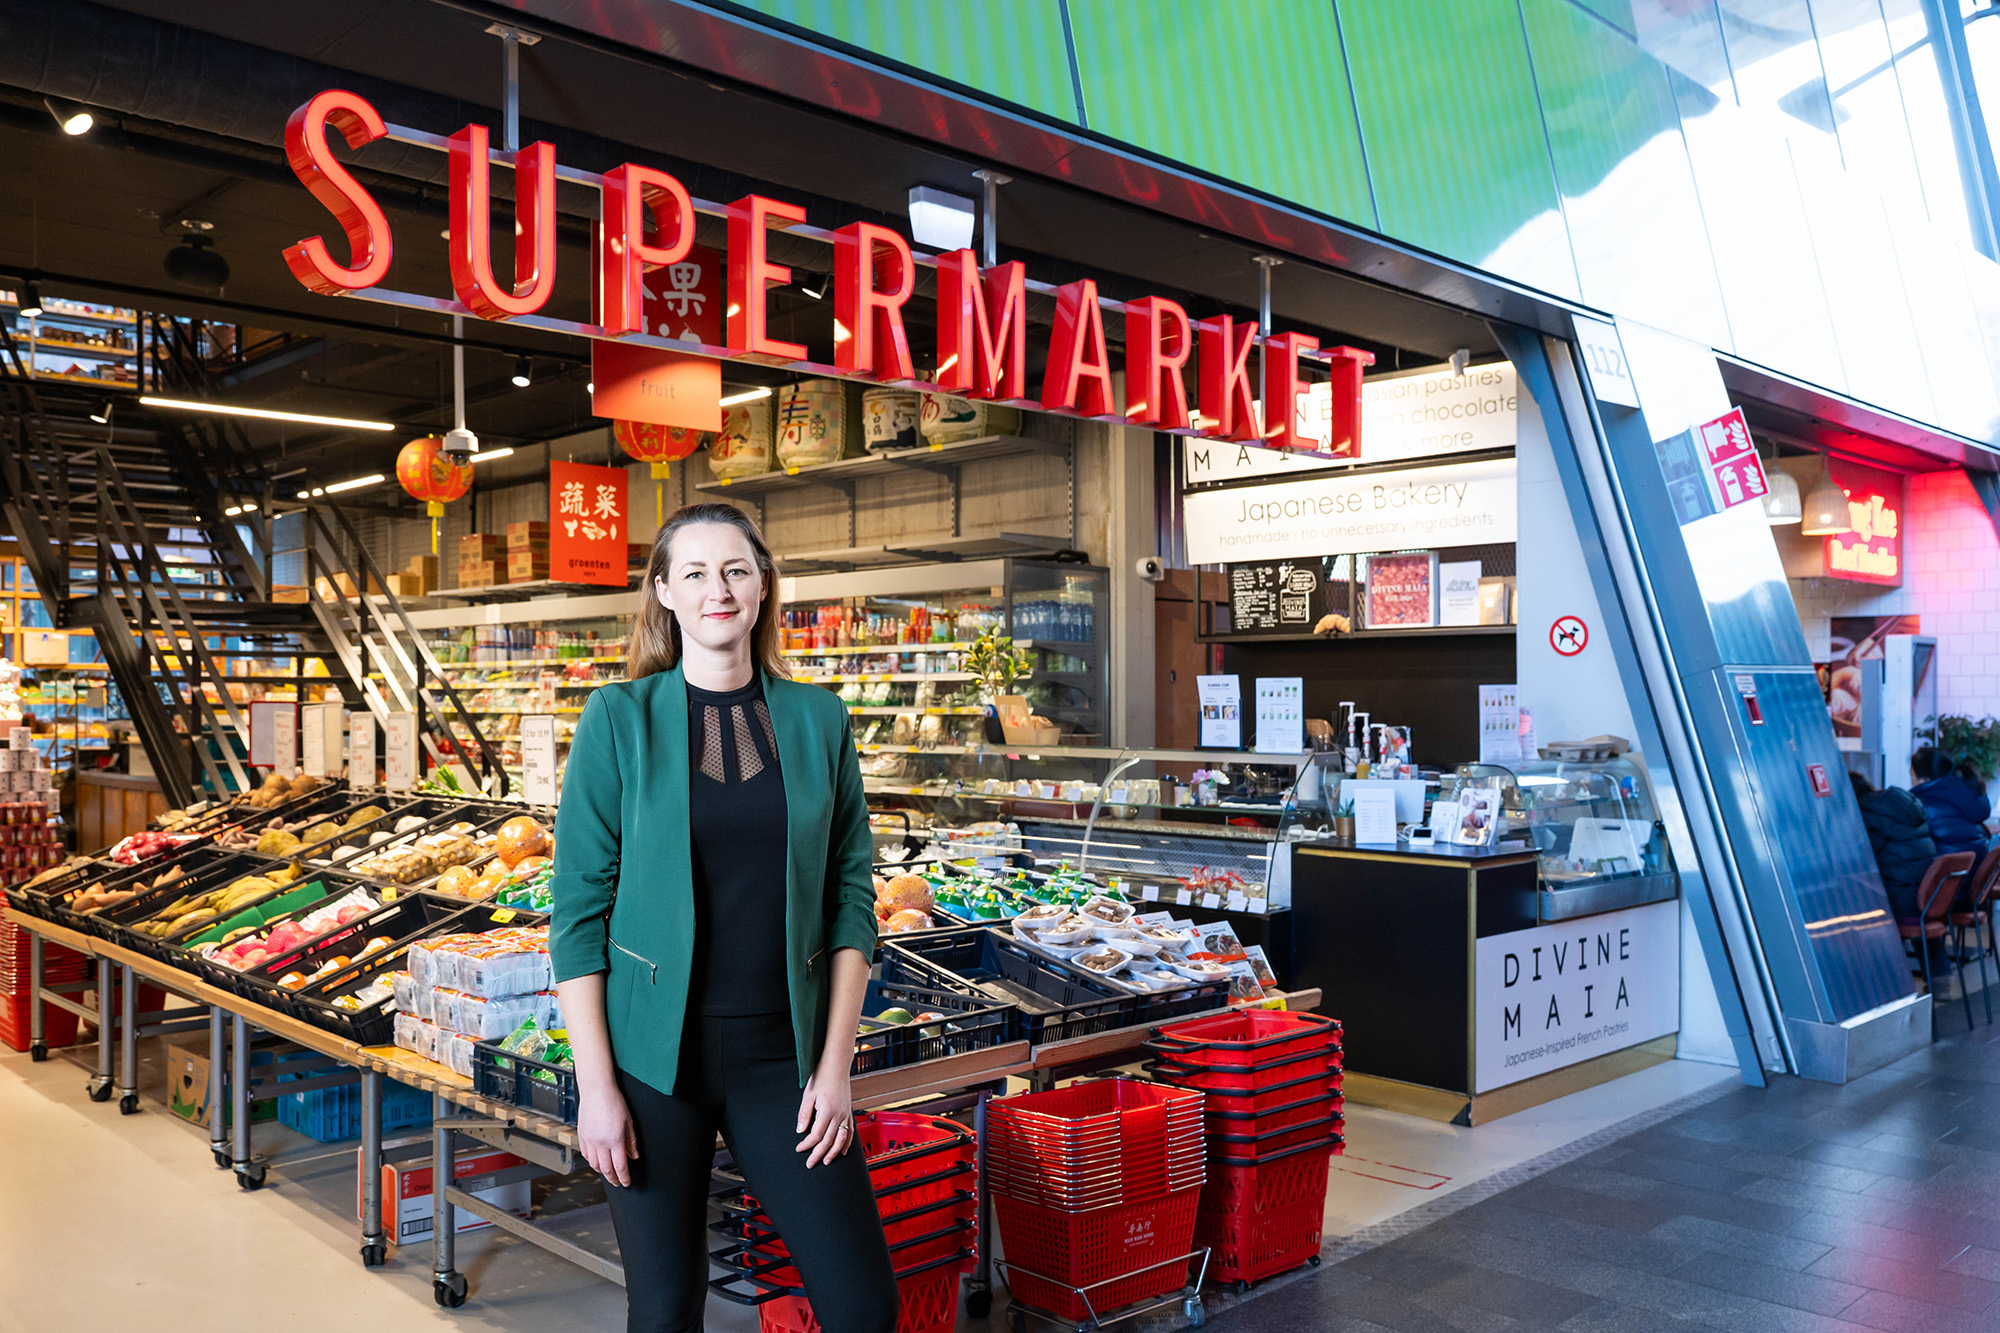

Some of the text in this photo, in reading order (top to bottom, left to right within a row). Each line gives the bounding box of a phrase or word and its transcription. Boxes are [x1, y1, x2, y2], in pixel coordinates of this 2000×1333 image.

[282, 88, 1377, 459] SUPERMARKET
[1586, 343, 1627, 379] 112
[641, 379, 677, 400] fruit
[1425, 369, 1503, 398] pastries
[1421, 431, 1474, 449] more
[560, 481, 621, 520] 蔬菜
[1237, 481, 1468, 525] Japanese Bakery
[1219, 529, 1290, 546] handmade
[1302, 528, 1318, 539] no
[1322, 522, 1406, 538] unnecessary
[1411, 512, 1493, 534] ingredients
[569, 558, 610, 569] groenten
[1371, 583, 1427, 594] DIVINE MAIA
[1504, 928, 1629, 989] DIVINE
[1504, 976, 1629, 1041] MAIA
[1504, 1021, 1630, 1068] Japanese-Inspired French Pastries
